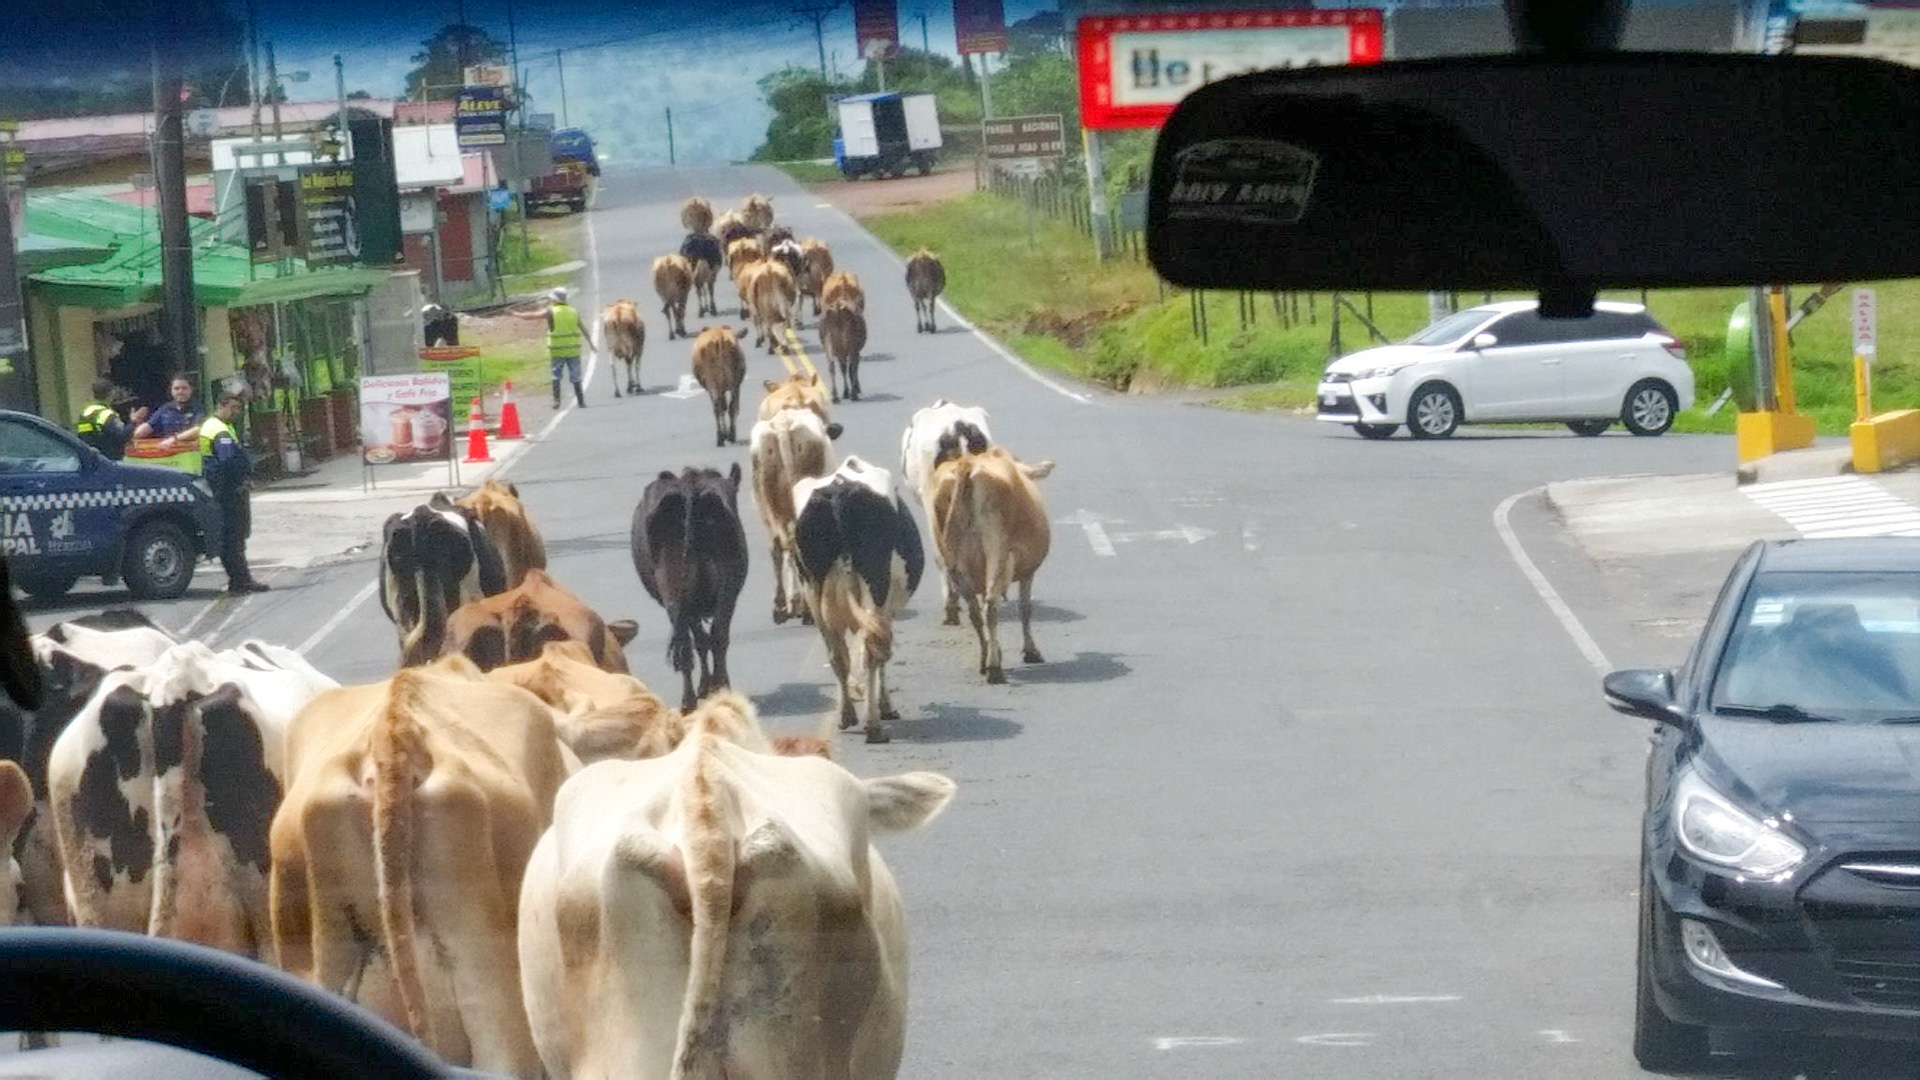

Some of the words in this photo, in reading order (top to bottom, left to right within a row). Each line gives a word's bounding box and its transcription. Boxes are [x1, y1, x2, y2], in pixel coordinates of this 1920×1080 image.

[1022, 121, 1059, 132] NACIONAL
[0, 512, 33, 537] IA
[0, 537, 41, 556] PAL
